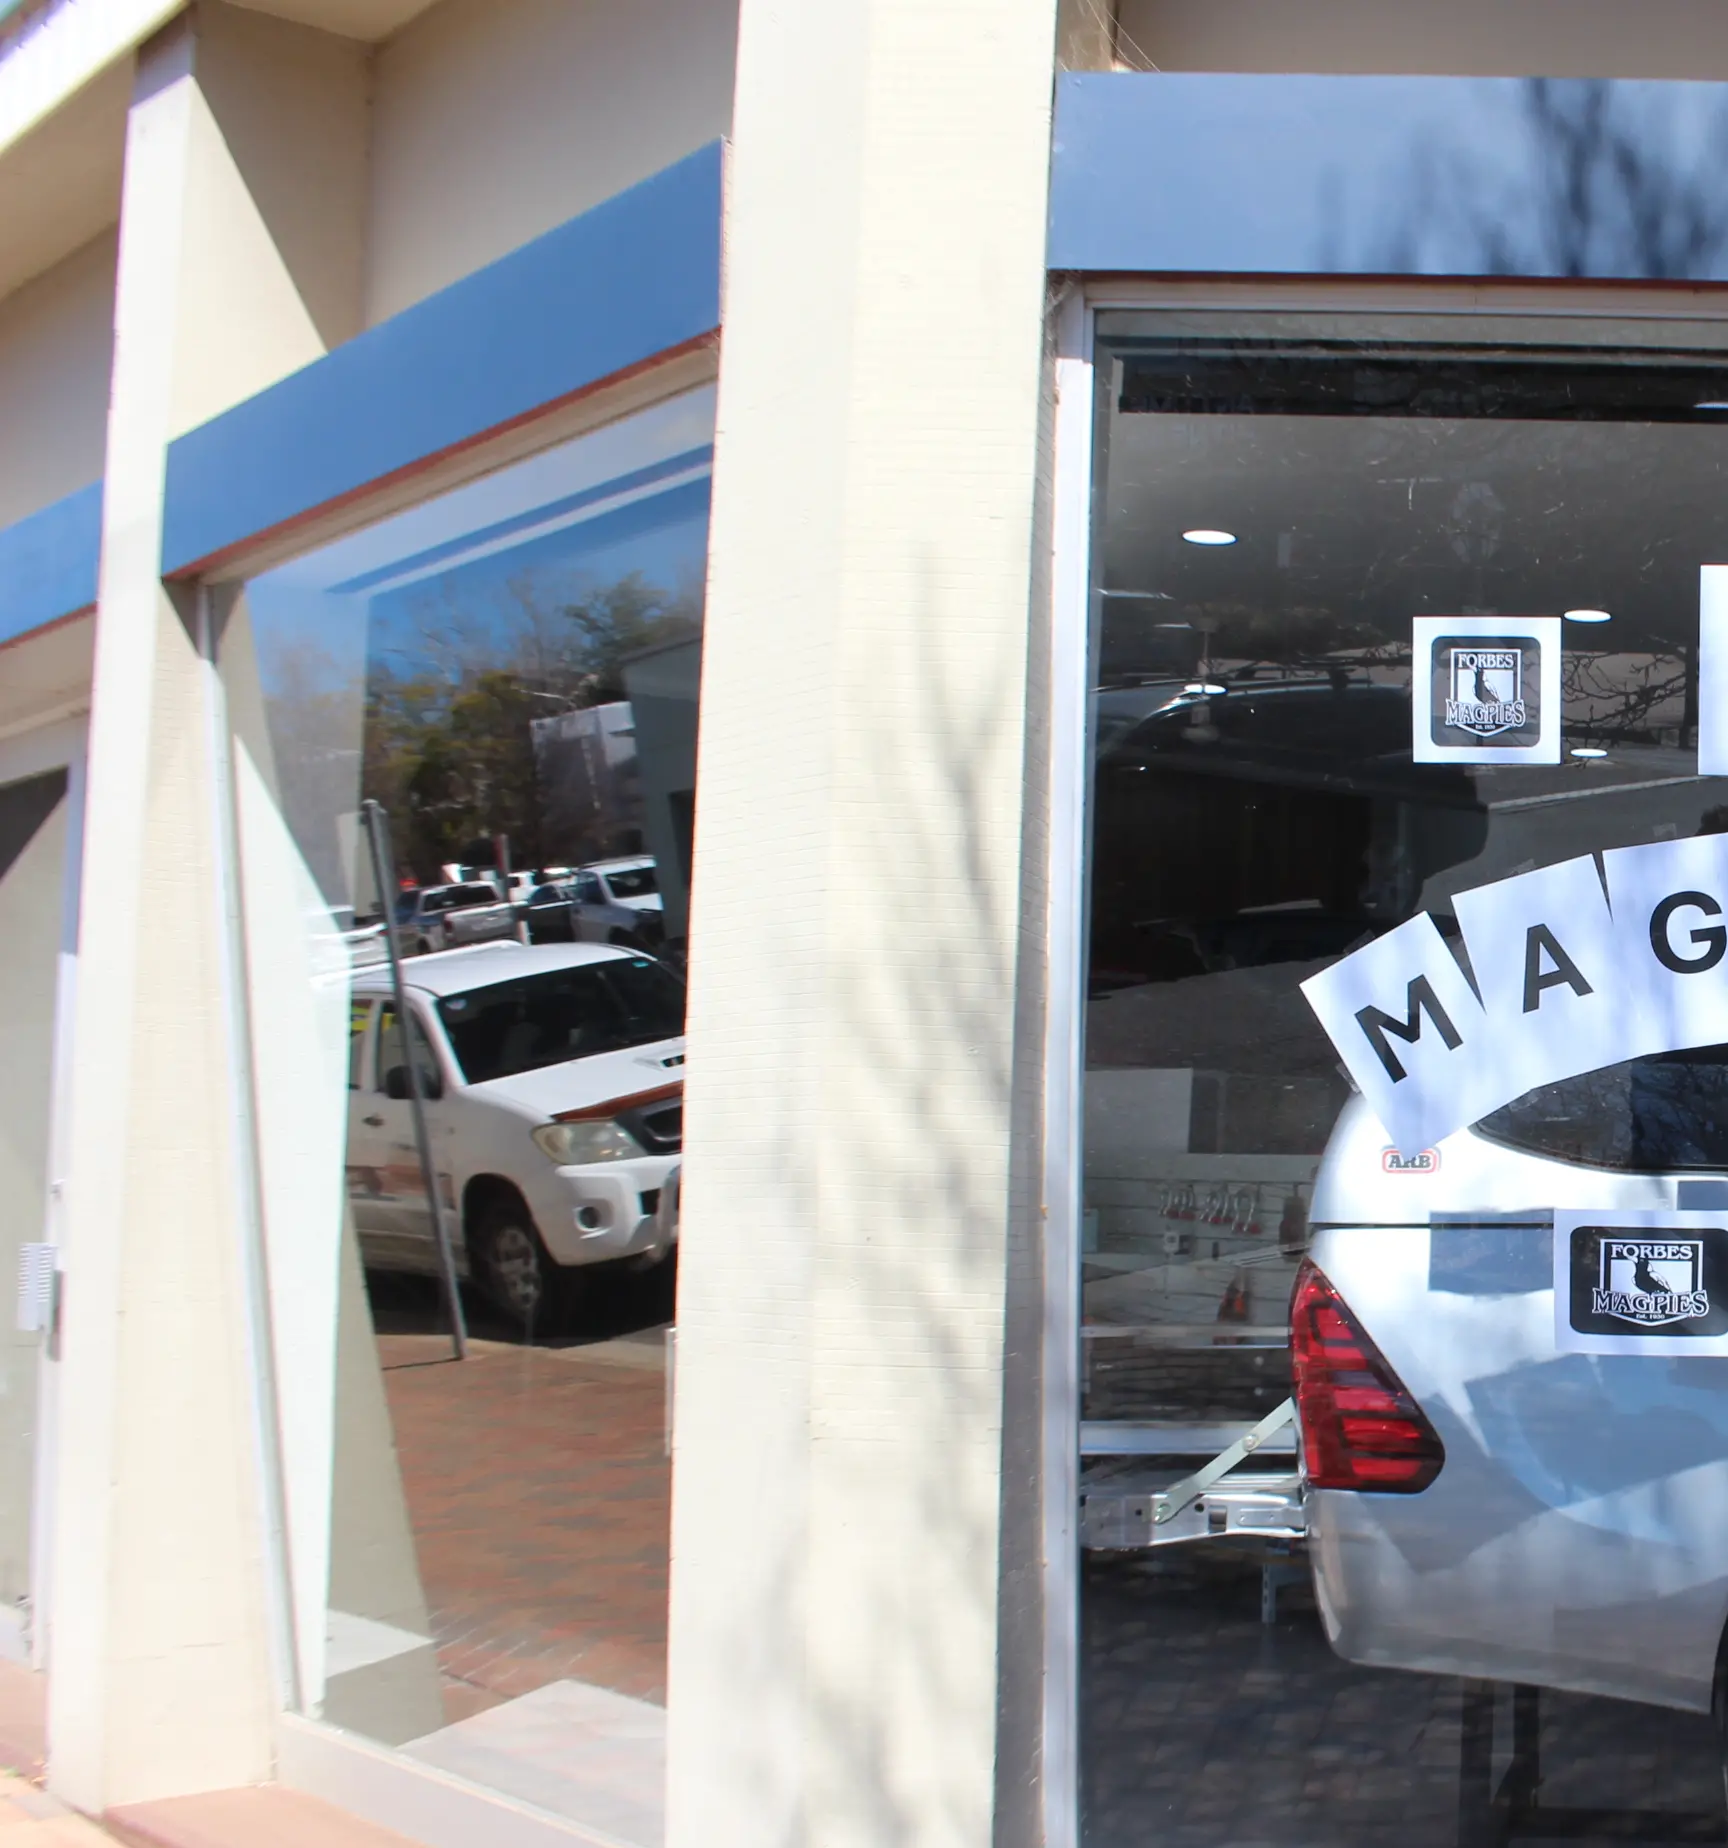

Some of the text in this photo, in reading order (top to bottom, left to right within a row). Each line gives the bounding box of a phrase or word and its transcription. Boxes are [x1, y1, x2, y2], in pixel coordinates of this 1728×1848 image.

[1457, 653, 1514, 668] FORBES
[1445, 698, 1526, 728] MAGPIES
[1611, 1243, 1693, 1260] FORBES
[1591, 1287, 1710, 1317] MAGPIES
